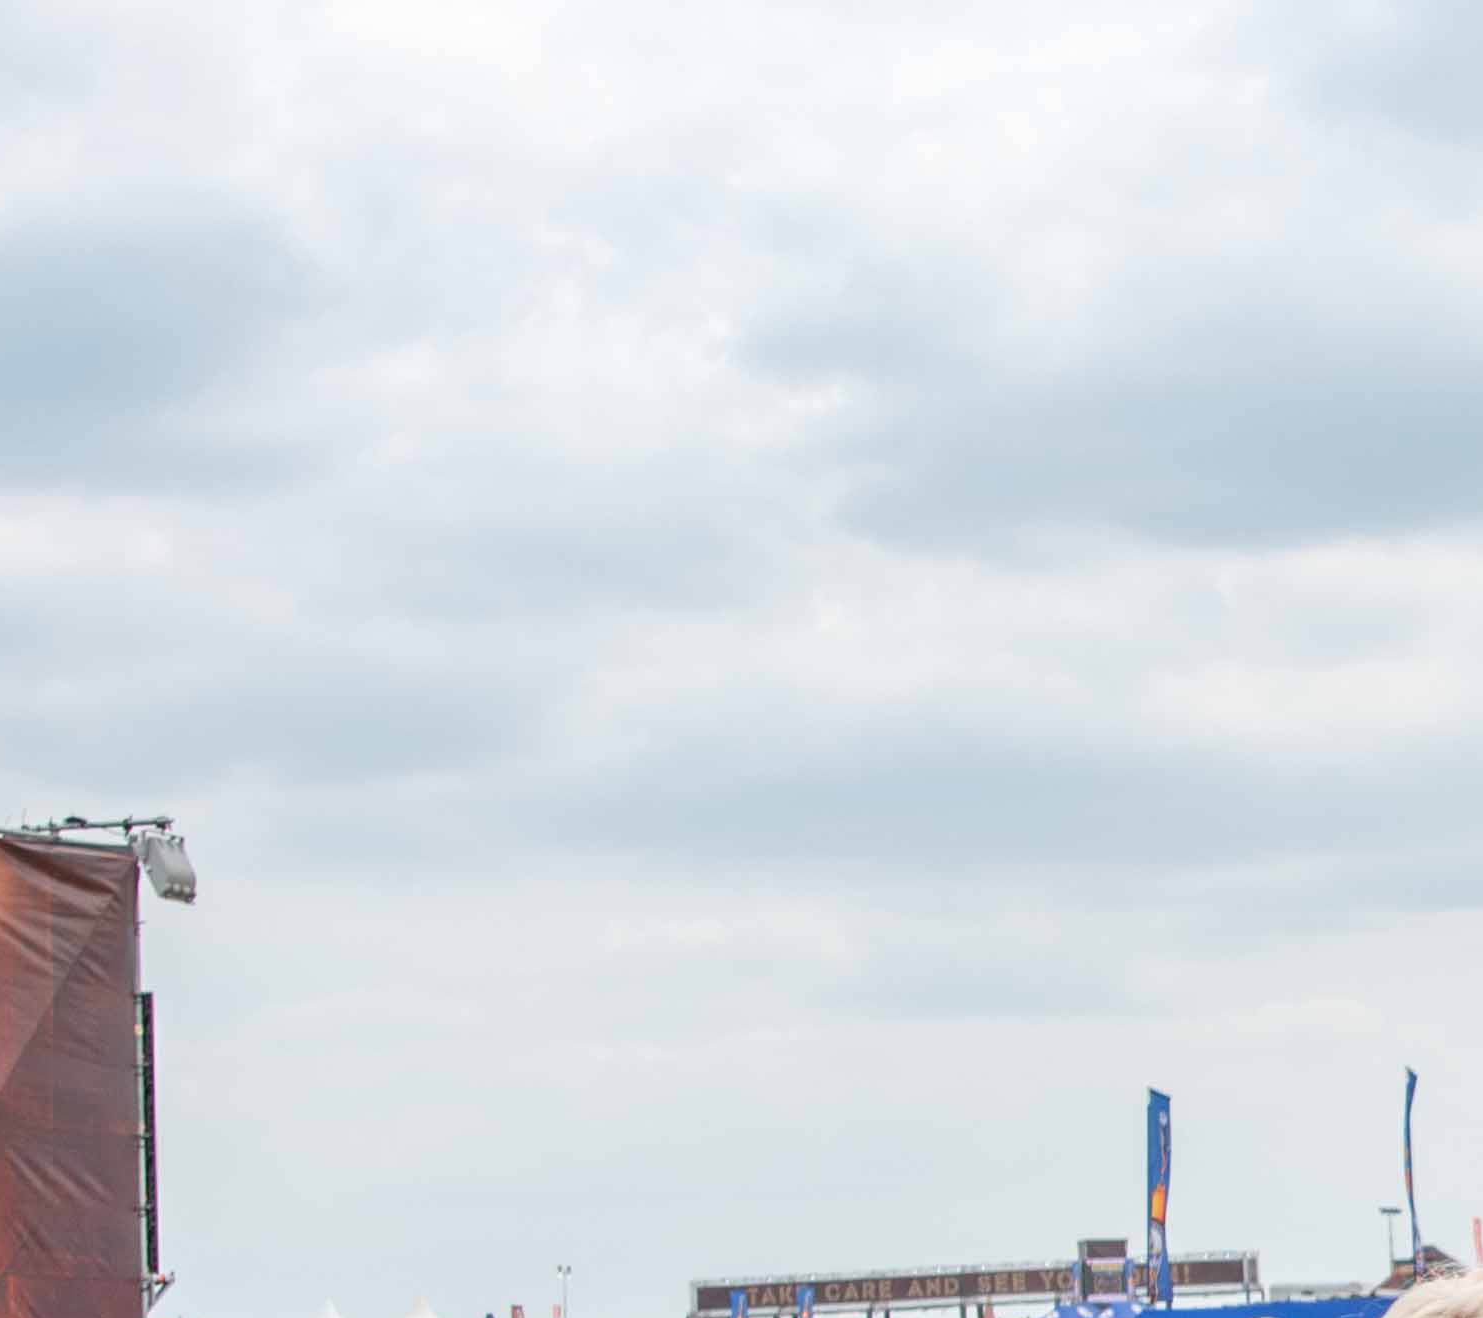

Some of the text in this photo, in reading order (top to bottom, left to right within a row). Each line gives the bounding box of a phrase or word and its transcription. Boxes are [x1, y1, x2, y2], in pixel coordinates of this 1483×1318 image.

[747, 1285, 795, 1306] TAK
[824, 1281, 893, 1301] CARE
[908, 1277, 960, 1297] AND
[977, 1270, 1027, 1292] SEE
